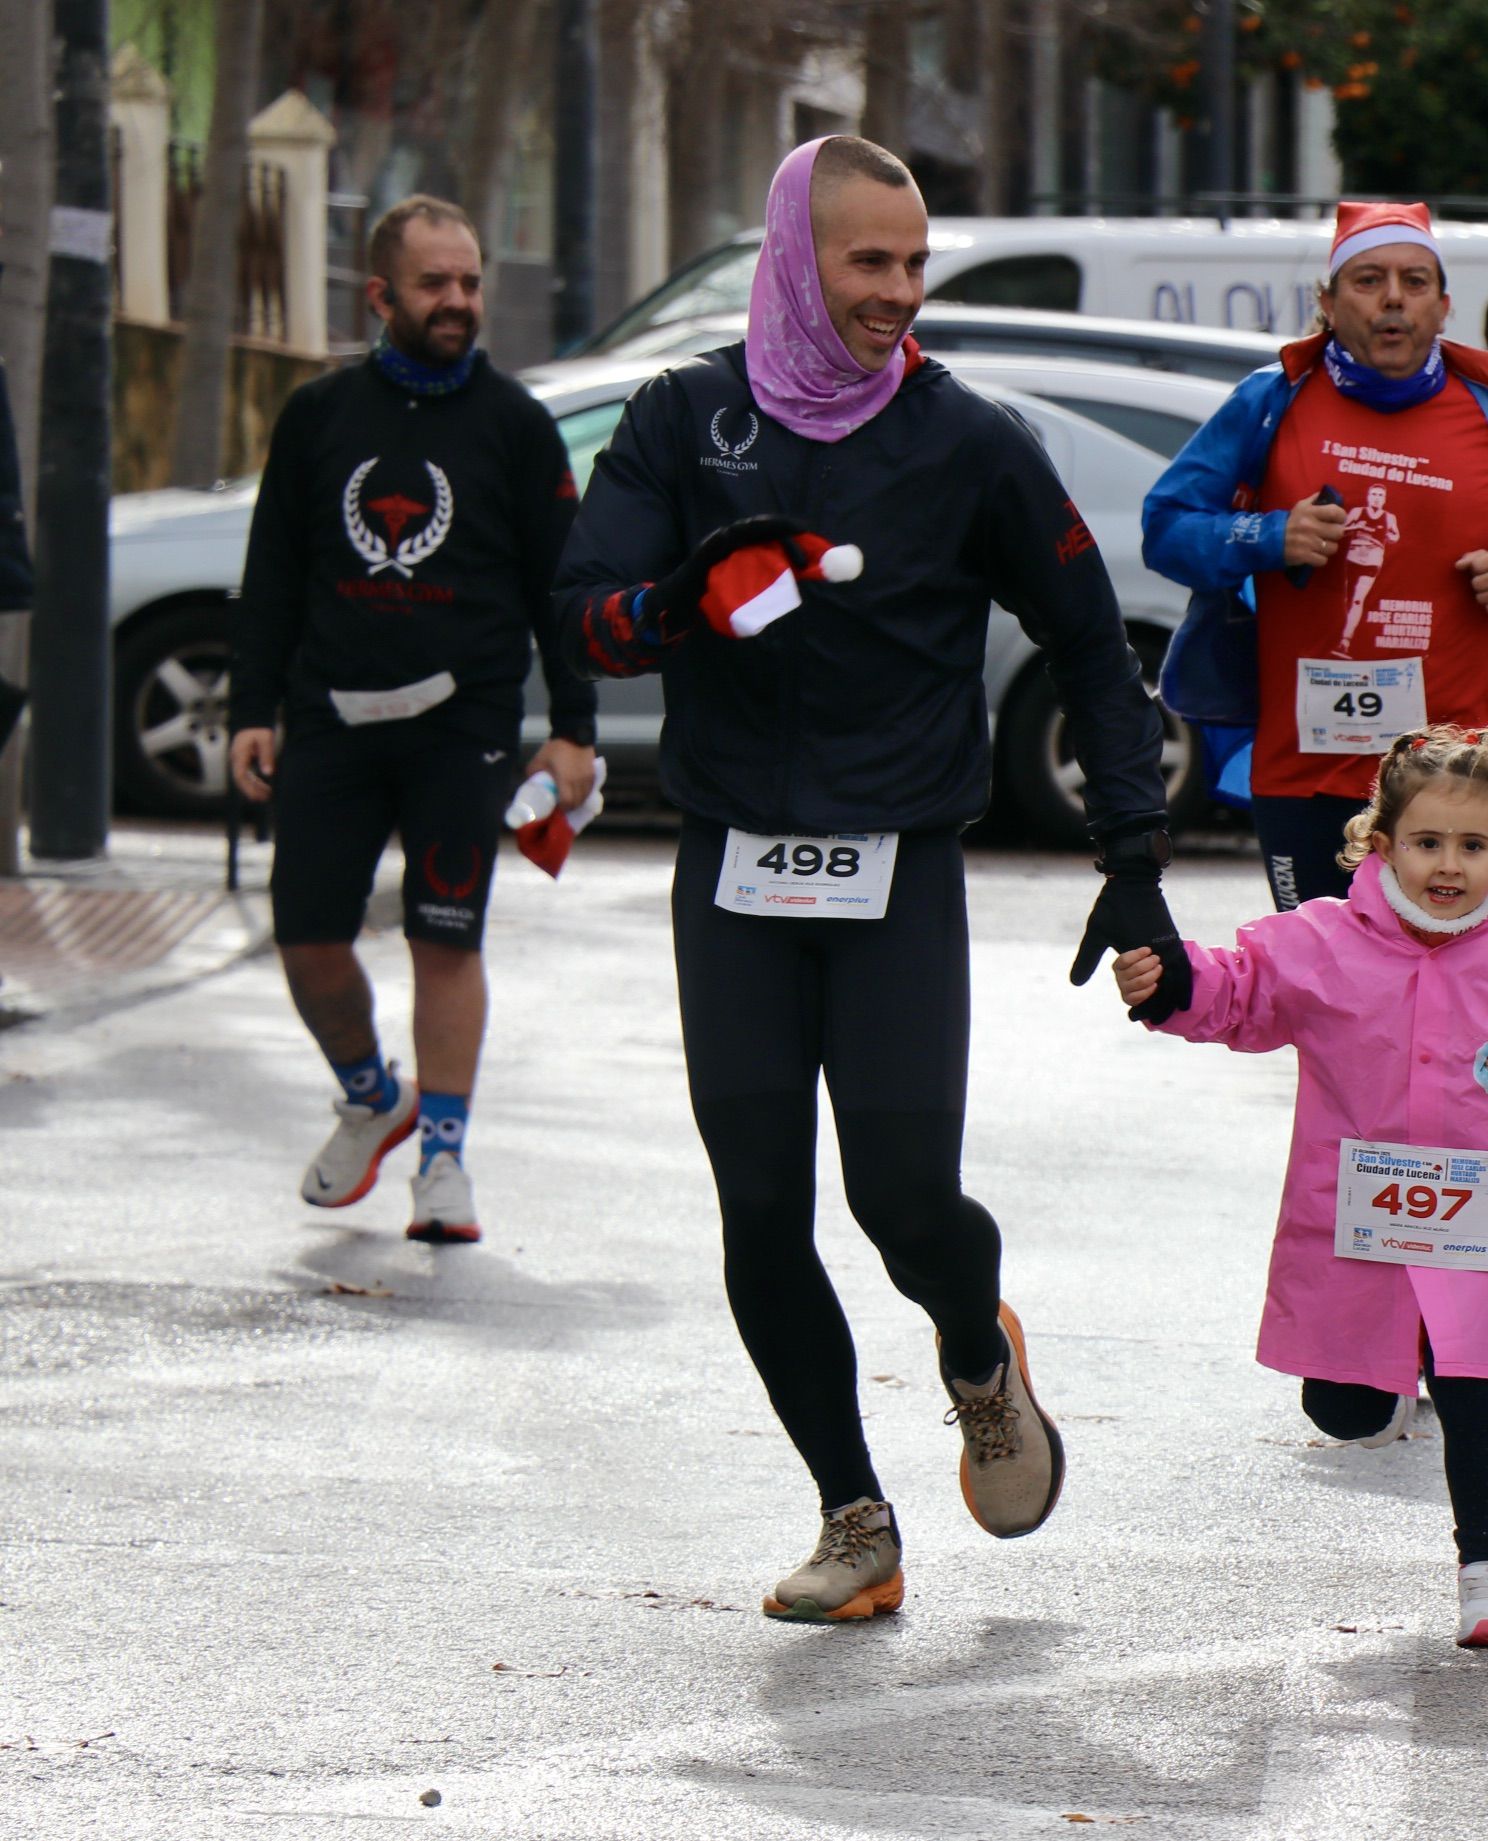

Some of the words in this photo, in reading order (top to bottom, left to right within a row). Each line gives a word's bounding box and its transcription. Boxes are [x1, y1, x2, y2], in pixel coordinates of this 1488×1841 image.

[1332, 442, 1357, 458] San
[1358, 446, 1418, 469] Silvestre
[700, 457, 737, 470] HERMES
[737, 462, 758, 471] GYM
[1338, 458, 1387, 479] Ciudad
[1387, 467, 1405, 482] de
[1406, 470, 1454, 492] Lucena
[1380, 599, 1433, 613] MEMORIAL
[1367, 611, 1391, 624] JOSE
[1393, 612, 1432, 626] CARLOS
[1383, 624, 1431, 638] HURTADO
[1375, 636, 1430, 650] MARJALIZO
[1333, 692, 1383, 717] 49
[756, 843, 861, 877] 498
[1272, 855, 1300, 906] LUCENA
[764, 894, 787, 904] vtv
[826, 896, 870, 904] enerplus
[1351, 1153, 1356, 1162] I
[1358, 1153, 1377, 1164] San
[1378, 1155, 1421, 1169] Silvestre
[1356, 1163, 1391, 1175] Ciudad
[1392, 1167, 1404, 1176] de
[1406, 1168, 1441, 1180] Lucena
[1371, 1183, 1473, 1221] 497
[1380, 1237, 1405, 1249] vtv
[1442, 1244, 1488, 1254] enerplus
